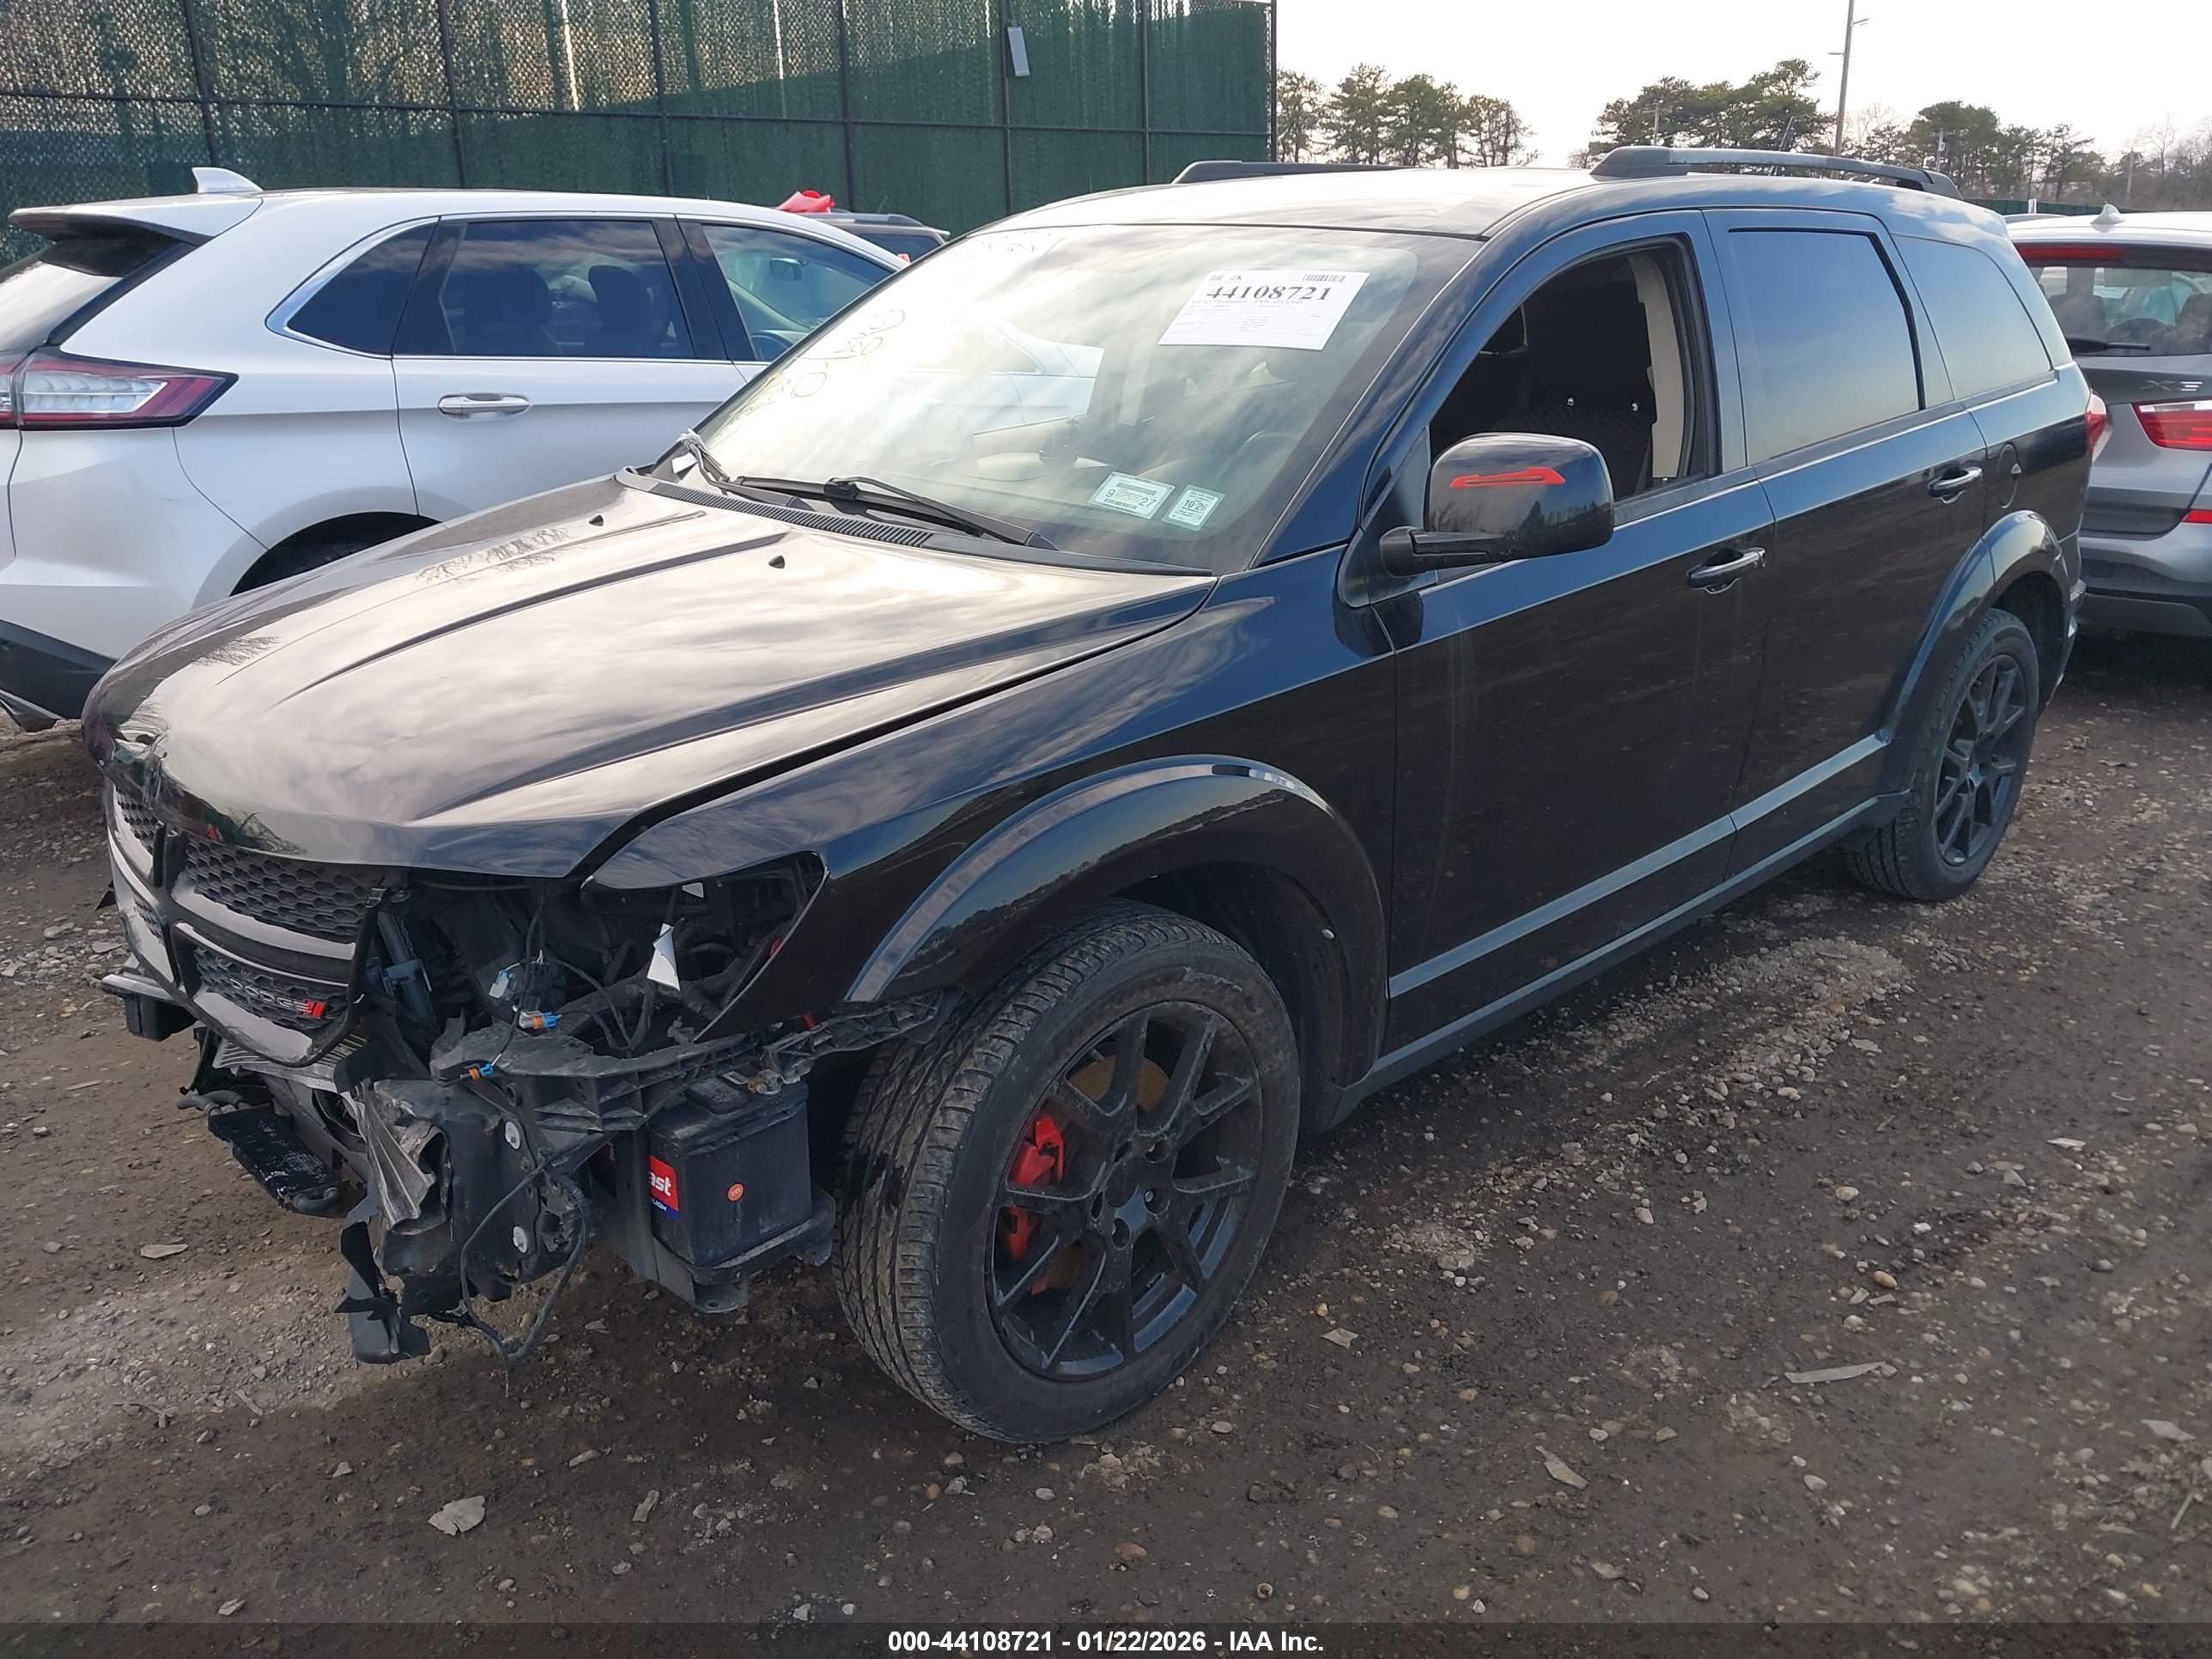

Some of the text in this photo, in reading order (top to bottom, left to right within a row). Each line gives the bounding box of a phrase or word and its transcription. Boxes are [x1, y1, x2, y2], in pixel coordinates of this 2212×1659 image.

[1206, 285, 1332, 301] 44108721
[1139, 496, 1157, 508] 27
[228, 977, 313, 1013] DODGE
